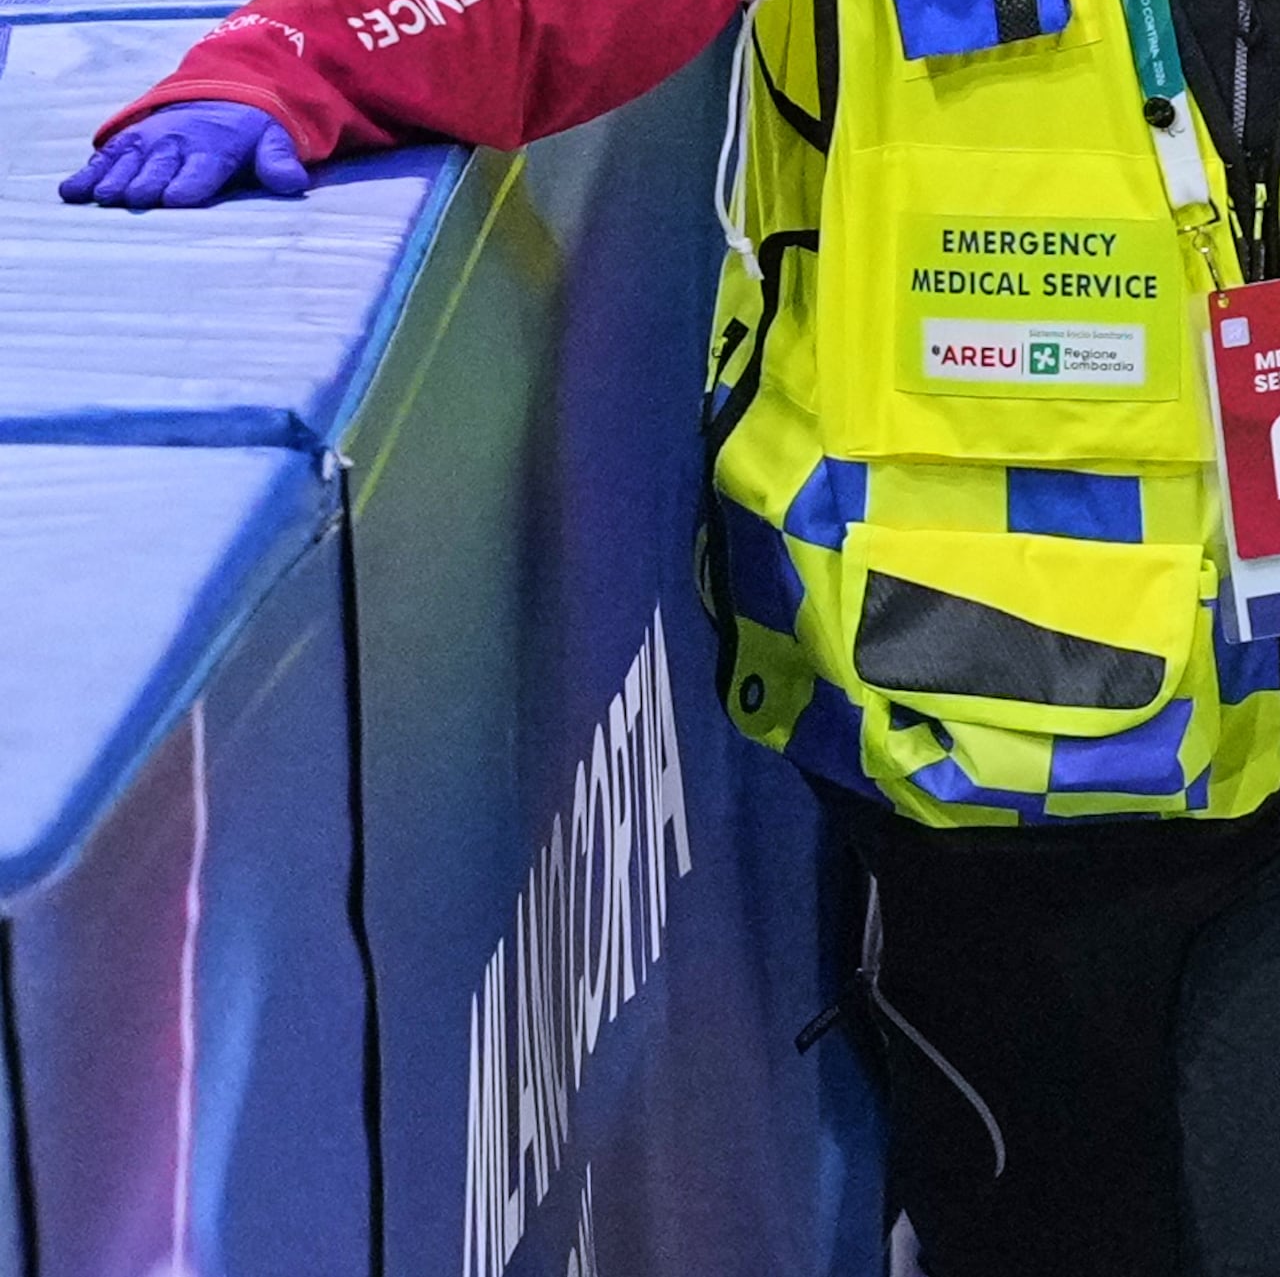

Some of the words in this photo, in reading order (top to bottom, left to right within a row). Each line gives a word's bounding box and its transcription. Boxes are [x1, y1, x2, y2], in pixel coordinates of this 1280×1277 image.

[942, 230, 1117, 257] EMERGENCY
[911, 269, 1030, 296] MEDICAL
[1042, 273, 1157, 299] SERVICE
[941, 345, 1017, 368] AREU
[1064, 348, 1117, 361] Regione
[1064, 361, 1134, 372] Lombardia
[569, 597, 692, 1094] CORTINA
